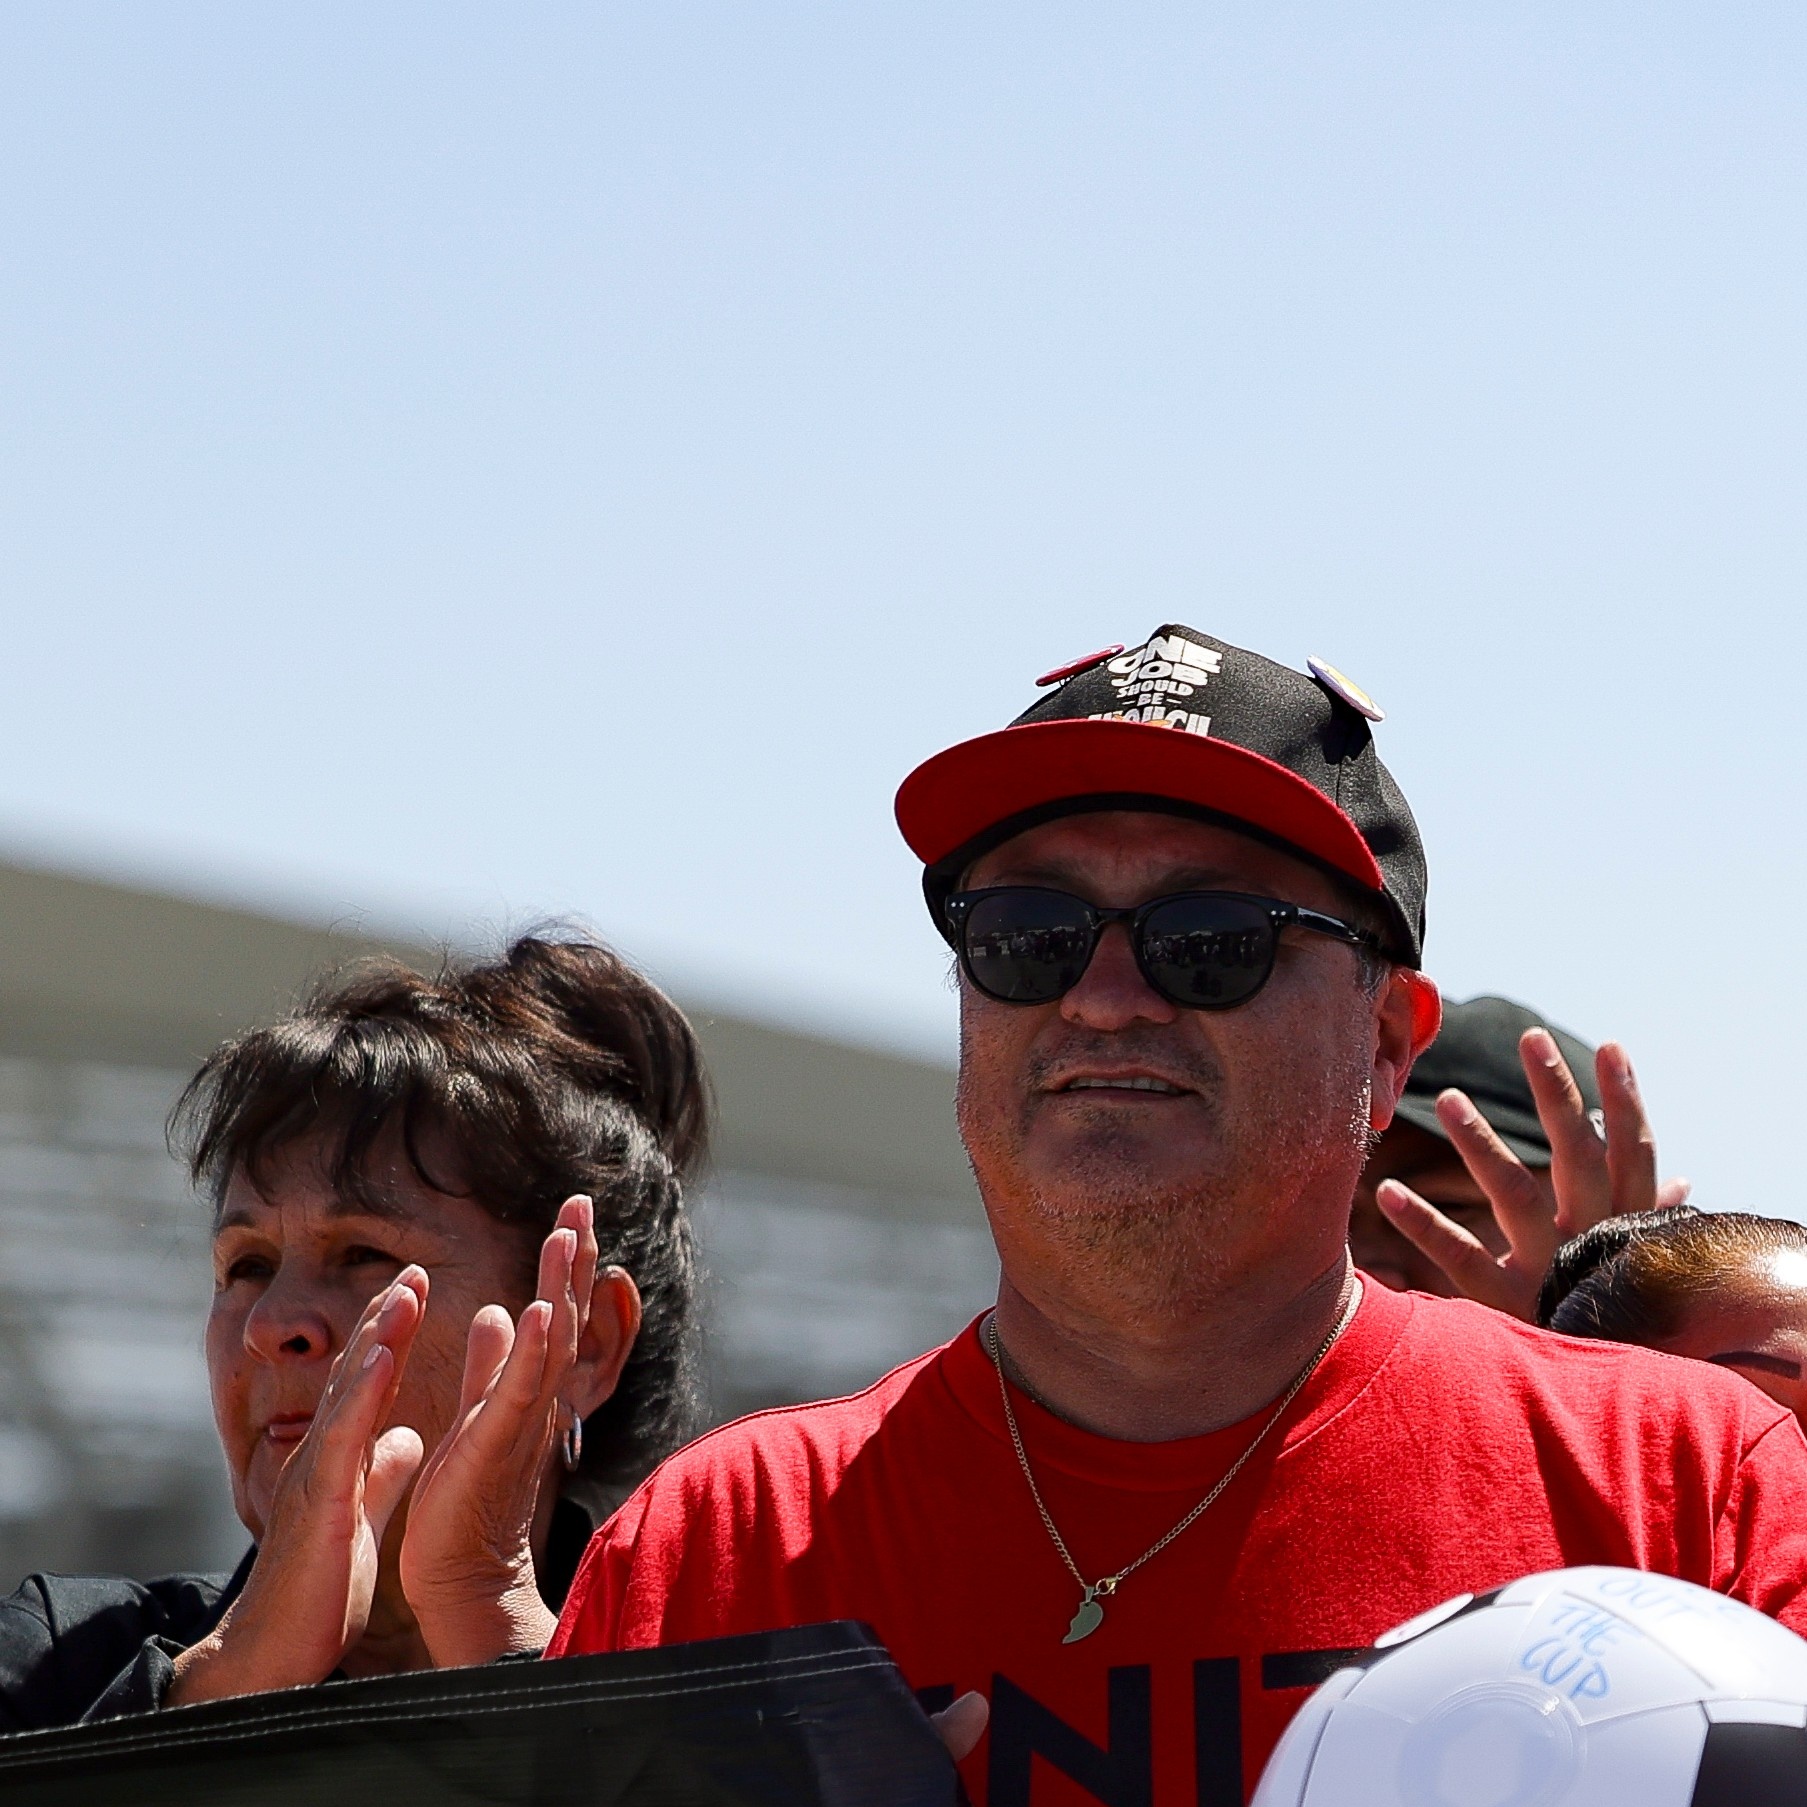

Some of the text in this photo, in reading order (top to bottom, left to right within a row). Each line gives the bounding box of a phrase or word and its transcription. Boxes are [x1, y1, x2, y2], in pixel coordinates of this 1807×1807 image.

[1107, 635, 1223, 674] ONE
[1111, 661, 1208, 687] JOB
[1116, 679, 1194, 698] SHOULD
[1138, 692, 1164, 706] BE
[1520, 1637, 1610, 1699] CUP
